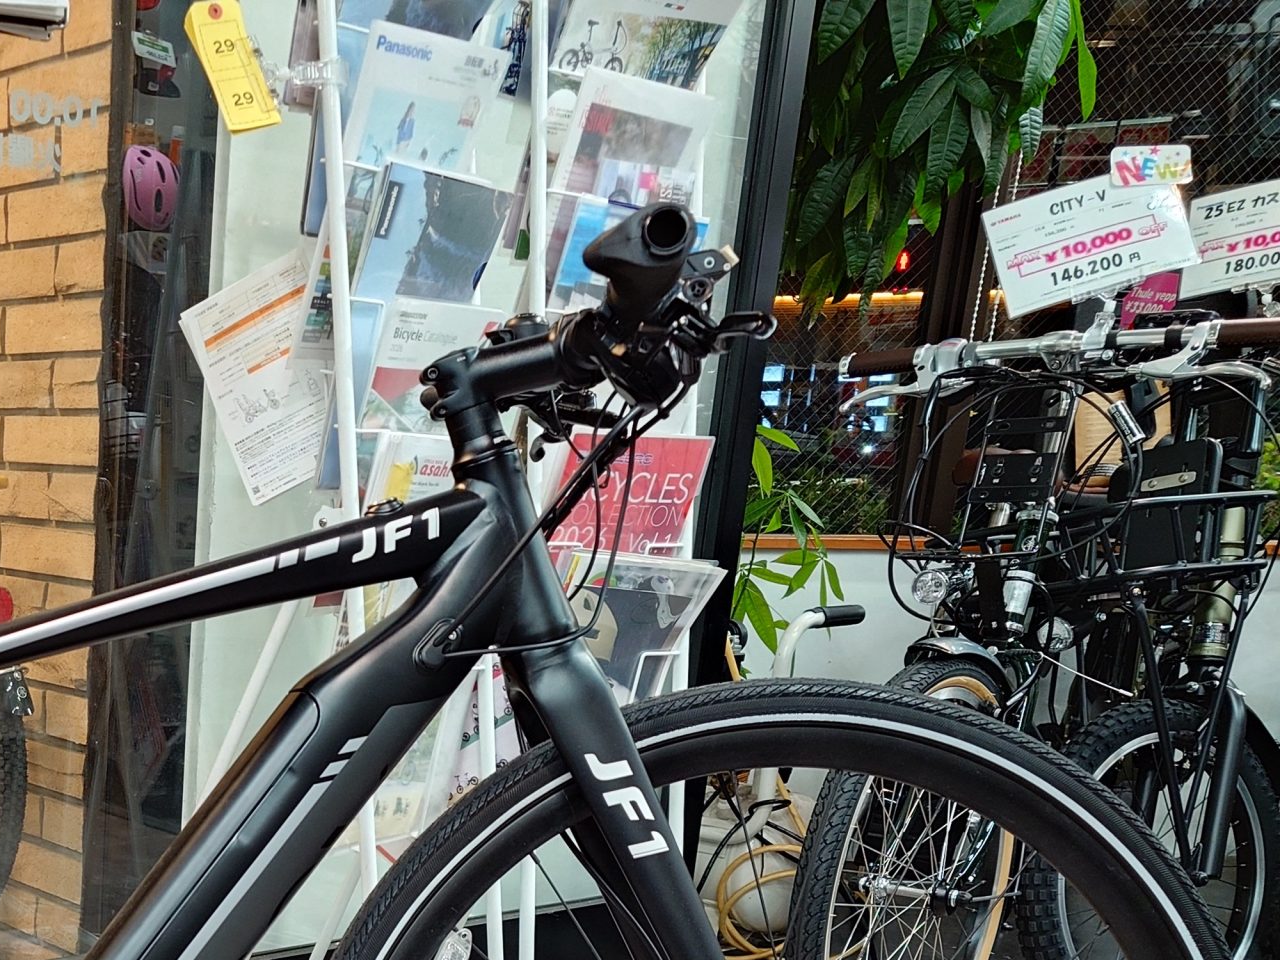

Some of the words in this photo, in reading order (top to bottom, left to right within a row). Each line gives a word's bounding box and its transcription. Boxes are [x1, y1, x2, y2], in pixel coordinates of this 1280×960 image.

[213, 39, 235, 54] 29
[376, 35, 433, 61] Panasonic
[231, 92, 254, 106] 29
[380, 186, 399, 235] Panasonic
[1007, 250, 1042, 270] MAX
[1044, 227, 1133, 265] ¥10,000
[1137, 220, 1168, 236] OFF
[1050, 252, 1124, 286] 146.200
[1128, 251, 1141, 264] 円
[1131, 286, 1154, 299] Thule
[1154, 292, 1177, 303] yepp
[393, 327, 424, 343] Bicycle
[582, 470, 694, 504] CYCLES
[351, 506, 440, 564] JF1
[583, 753, 670, 860] JF1
